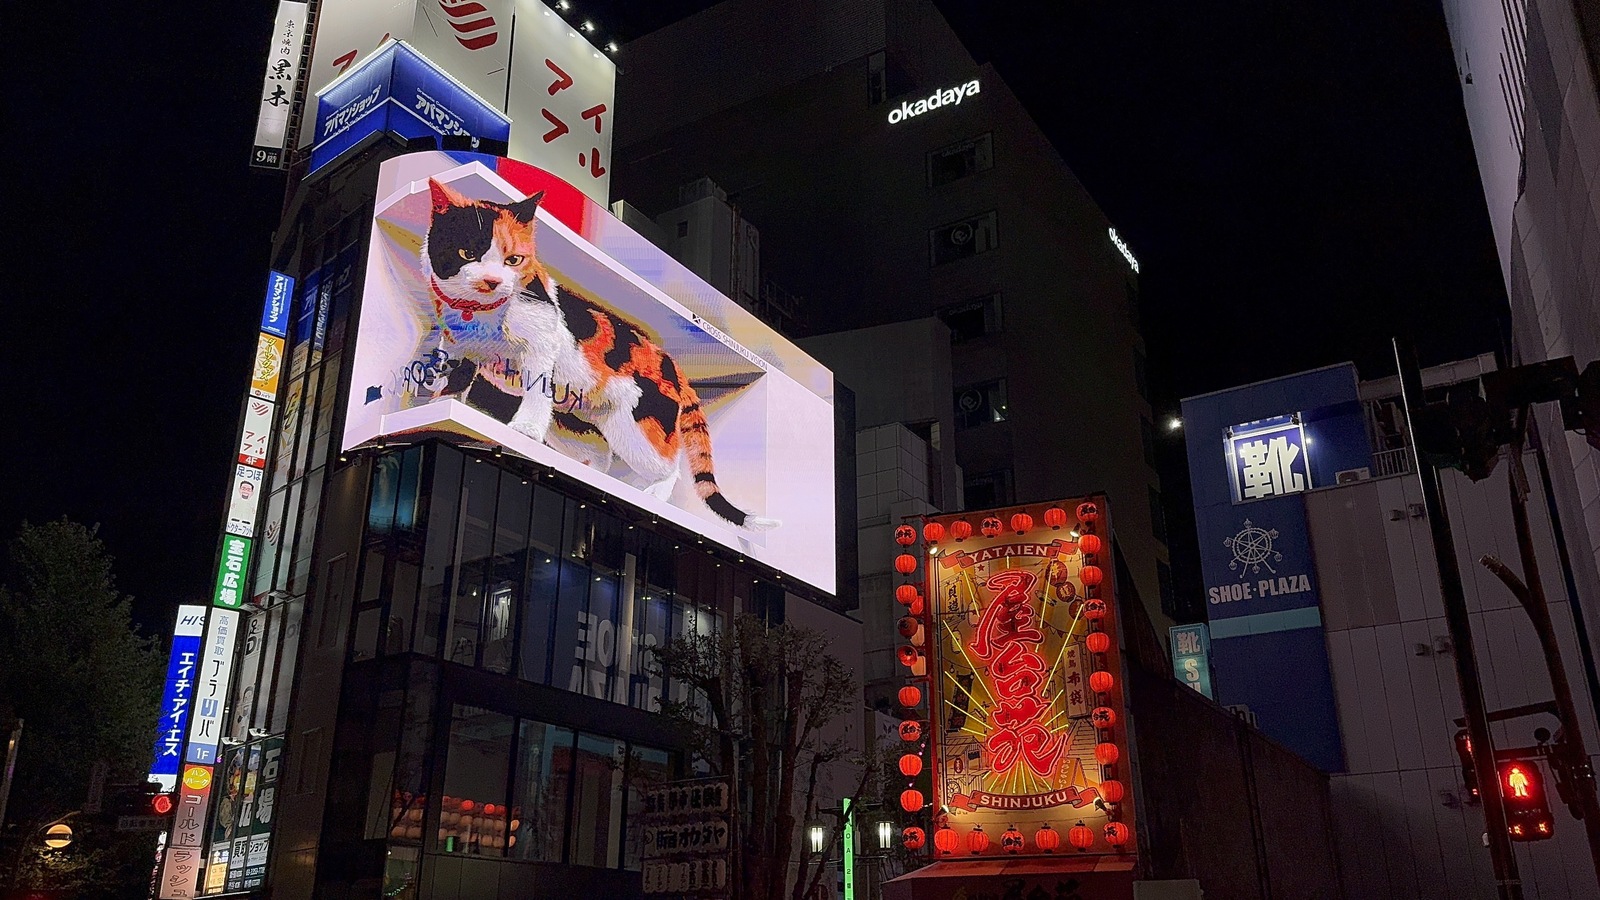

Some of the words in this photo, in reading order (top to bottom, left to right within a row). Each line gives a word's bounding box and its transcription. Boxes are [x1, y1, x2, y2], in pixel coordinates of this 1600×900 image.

[264, 59, 291, 107] 黒木
[887, 79, 981, 124] okadaya
[245, 456, 258, 465] 4F
[1240, 436, 1304, 498] 靴
[219, 539, 246, 605] 宝石広場
[968, 545, 1048, 563] YATAIEN
[213, 615, 230, 657] 高価買取
[1177, 631, 1200, 654] 靴
[198, 659, 225, 738] ブラリバ
[196, 747, 210, 760] 1F
[980, 791, 1068, 808] SHINJUKU
